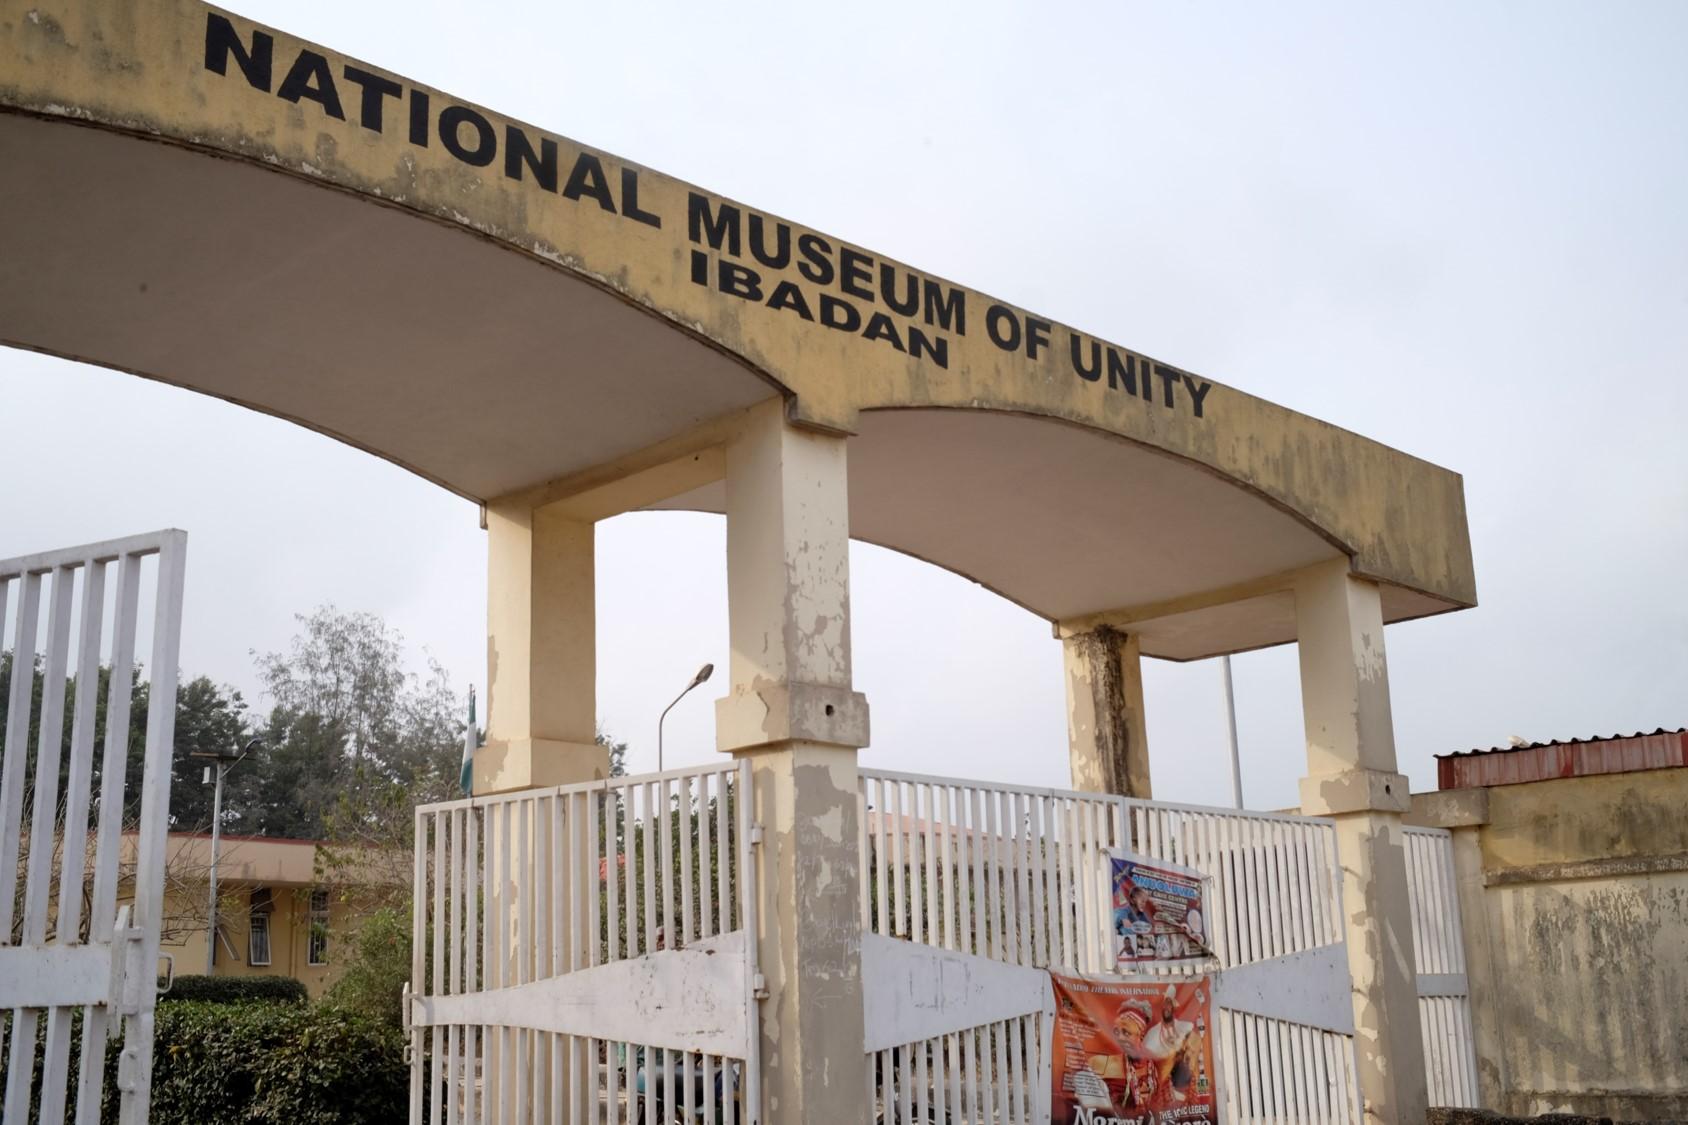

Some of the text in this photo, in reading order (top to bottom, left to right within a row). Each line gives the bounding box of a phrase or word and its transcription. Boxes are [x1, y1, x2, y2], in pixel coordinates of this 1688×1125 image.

[204, 11, 1211, 418] NATIONAL MUSEUM OF UNITY
[690, 249, 948, 369] IBADAN
[1158, 1109, 1173, 1120] THE
[1188, 1104, 1210, 1115] LEGEND
